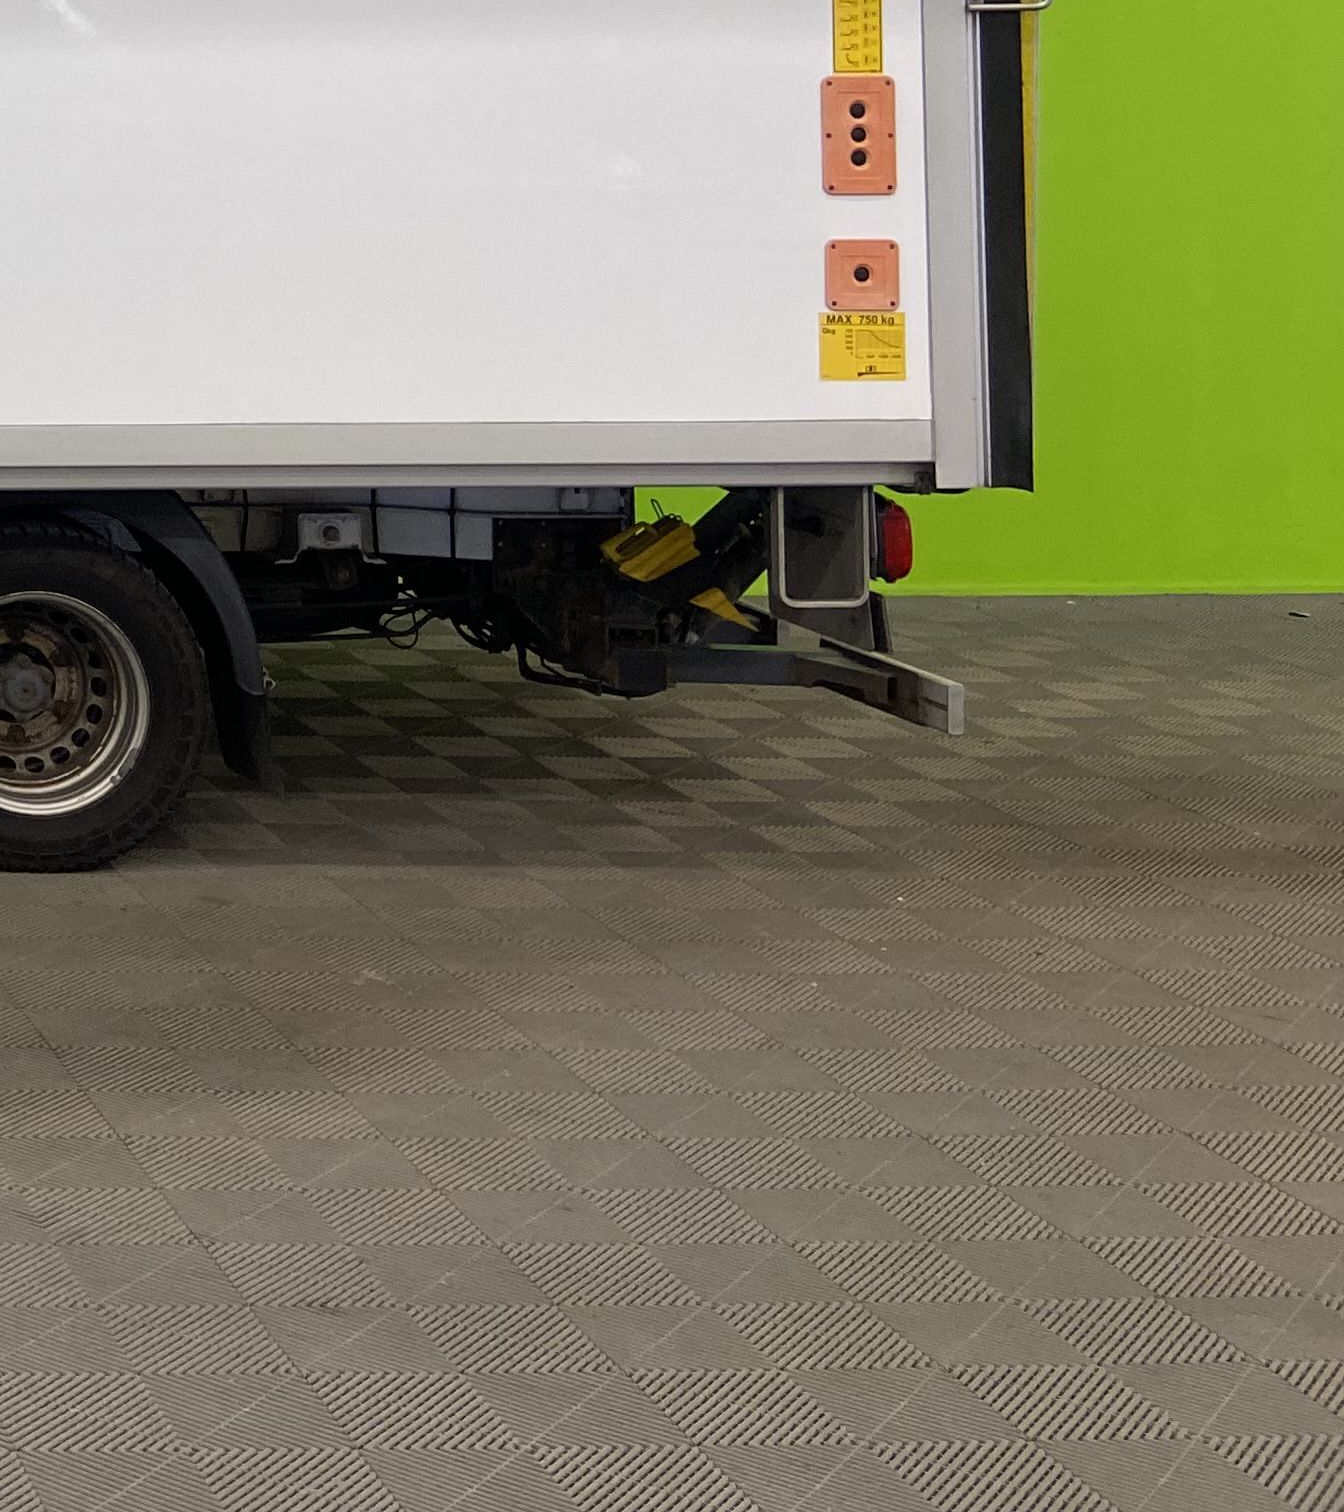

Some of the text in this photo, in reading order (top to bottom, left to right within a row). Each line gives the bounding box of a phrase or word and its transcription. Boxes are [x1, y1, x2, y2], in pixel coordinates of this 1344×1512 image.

[826, 315, 895, 326] MAX 750 kg
